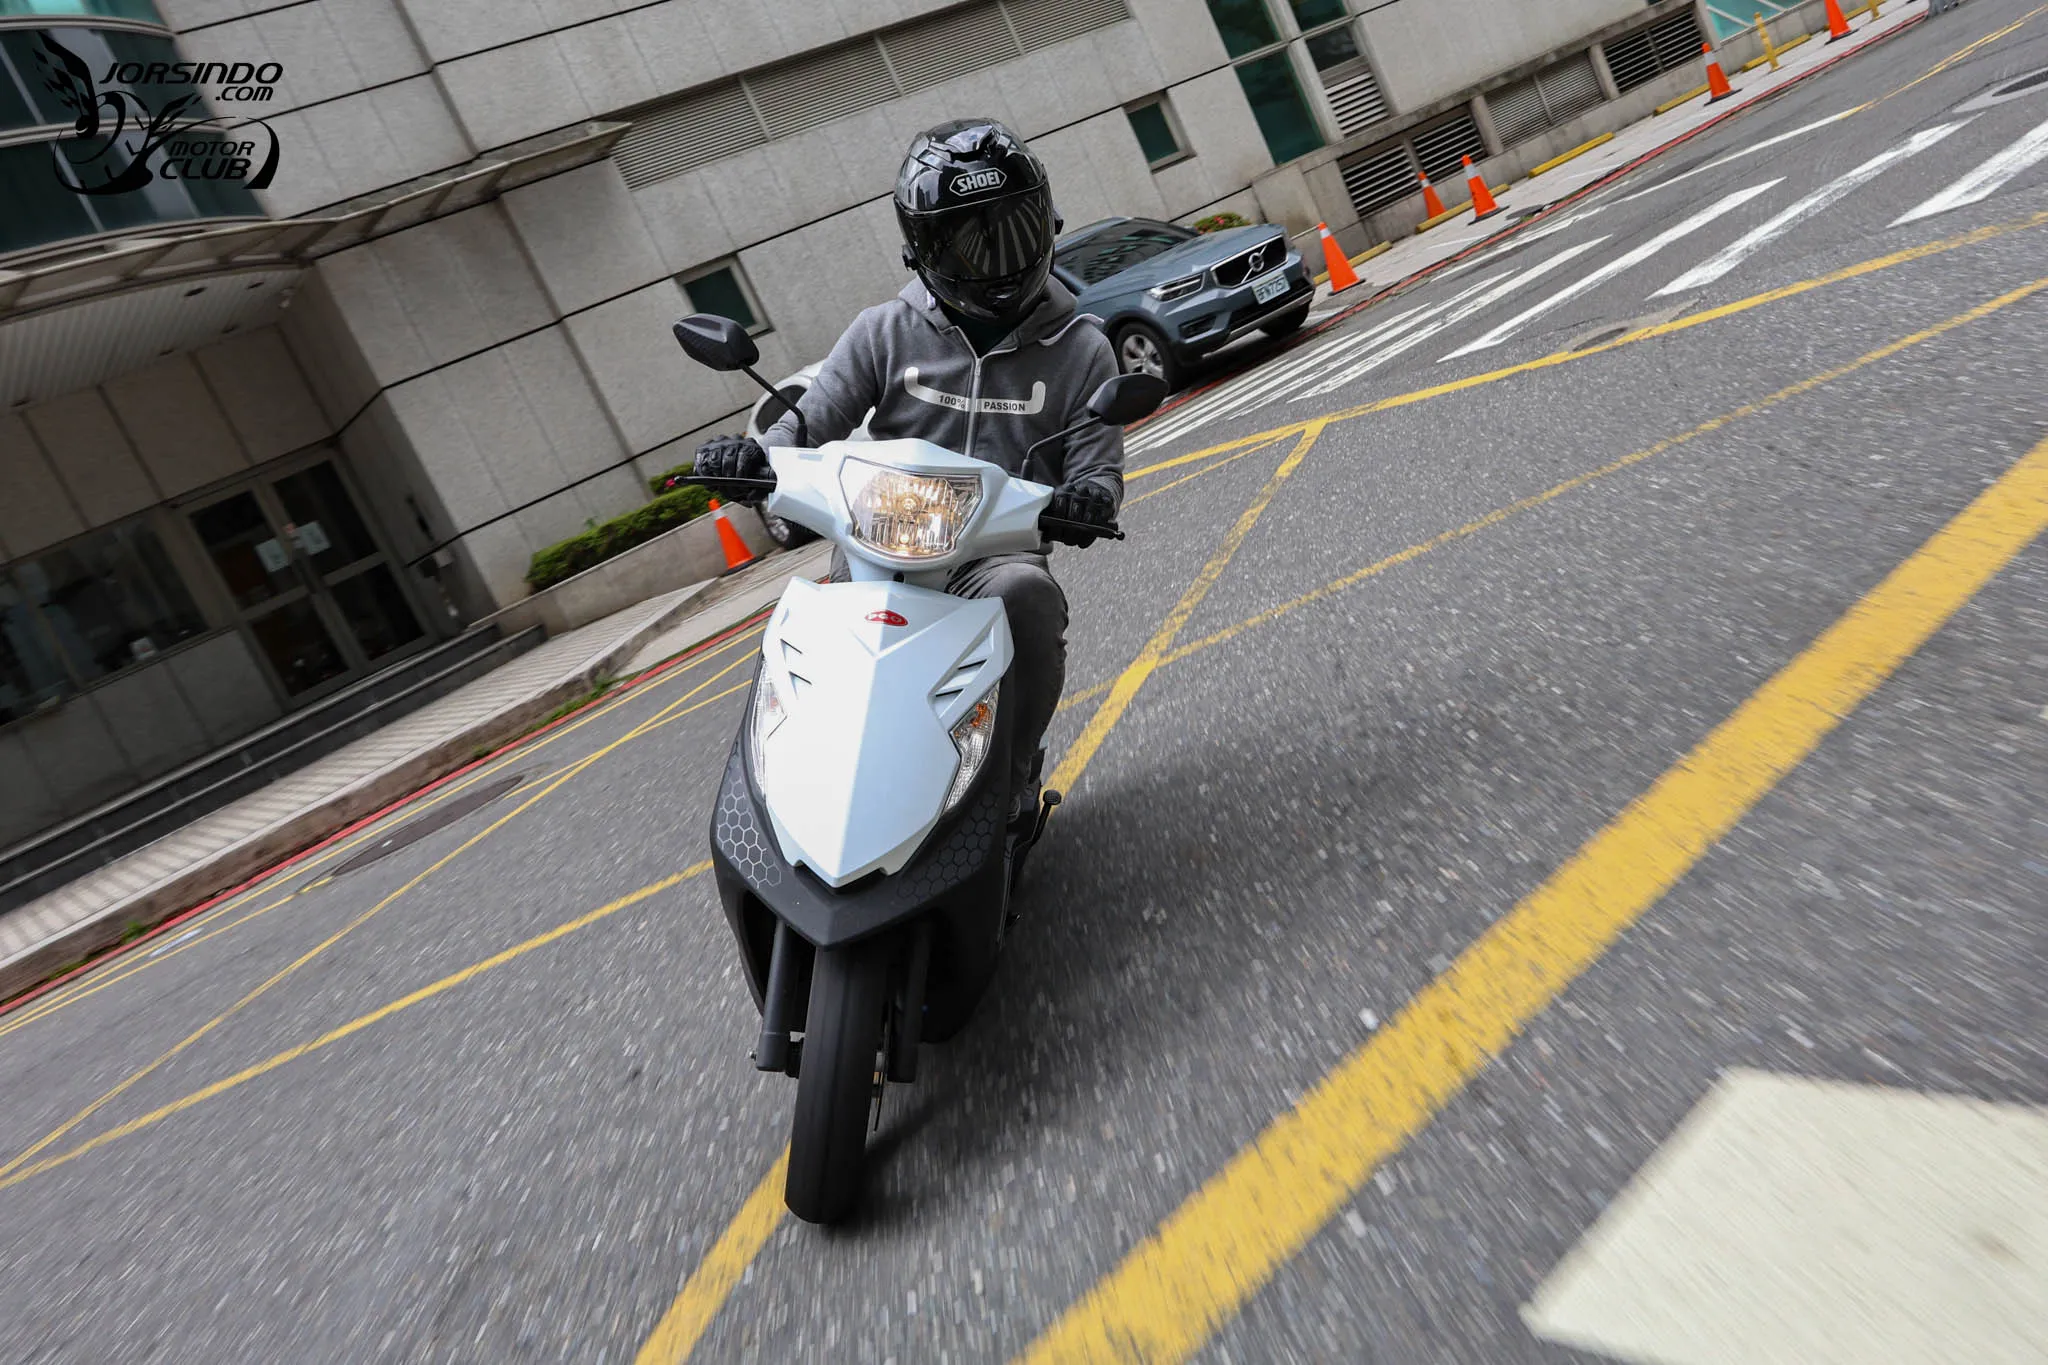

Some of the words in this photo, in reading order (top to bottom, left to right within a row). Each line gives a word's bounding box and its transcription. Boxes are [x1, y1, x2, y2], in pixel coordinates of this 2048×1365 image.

[957, 171, 1001, 193] SHOEI
[939, 394, 966, 409] 100%
[983, 401, 1026, 411] PASSION
